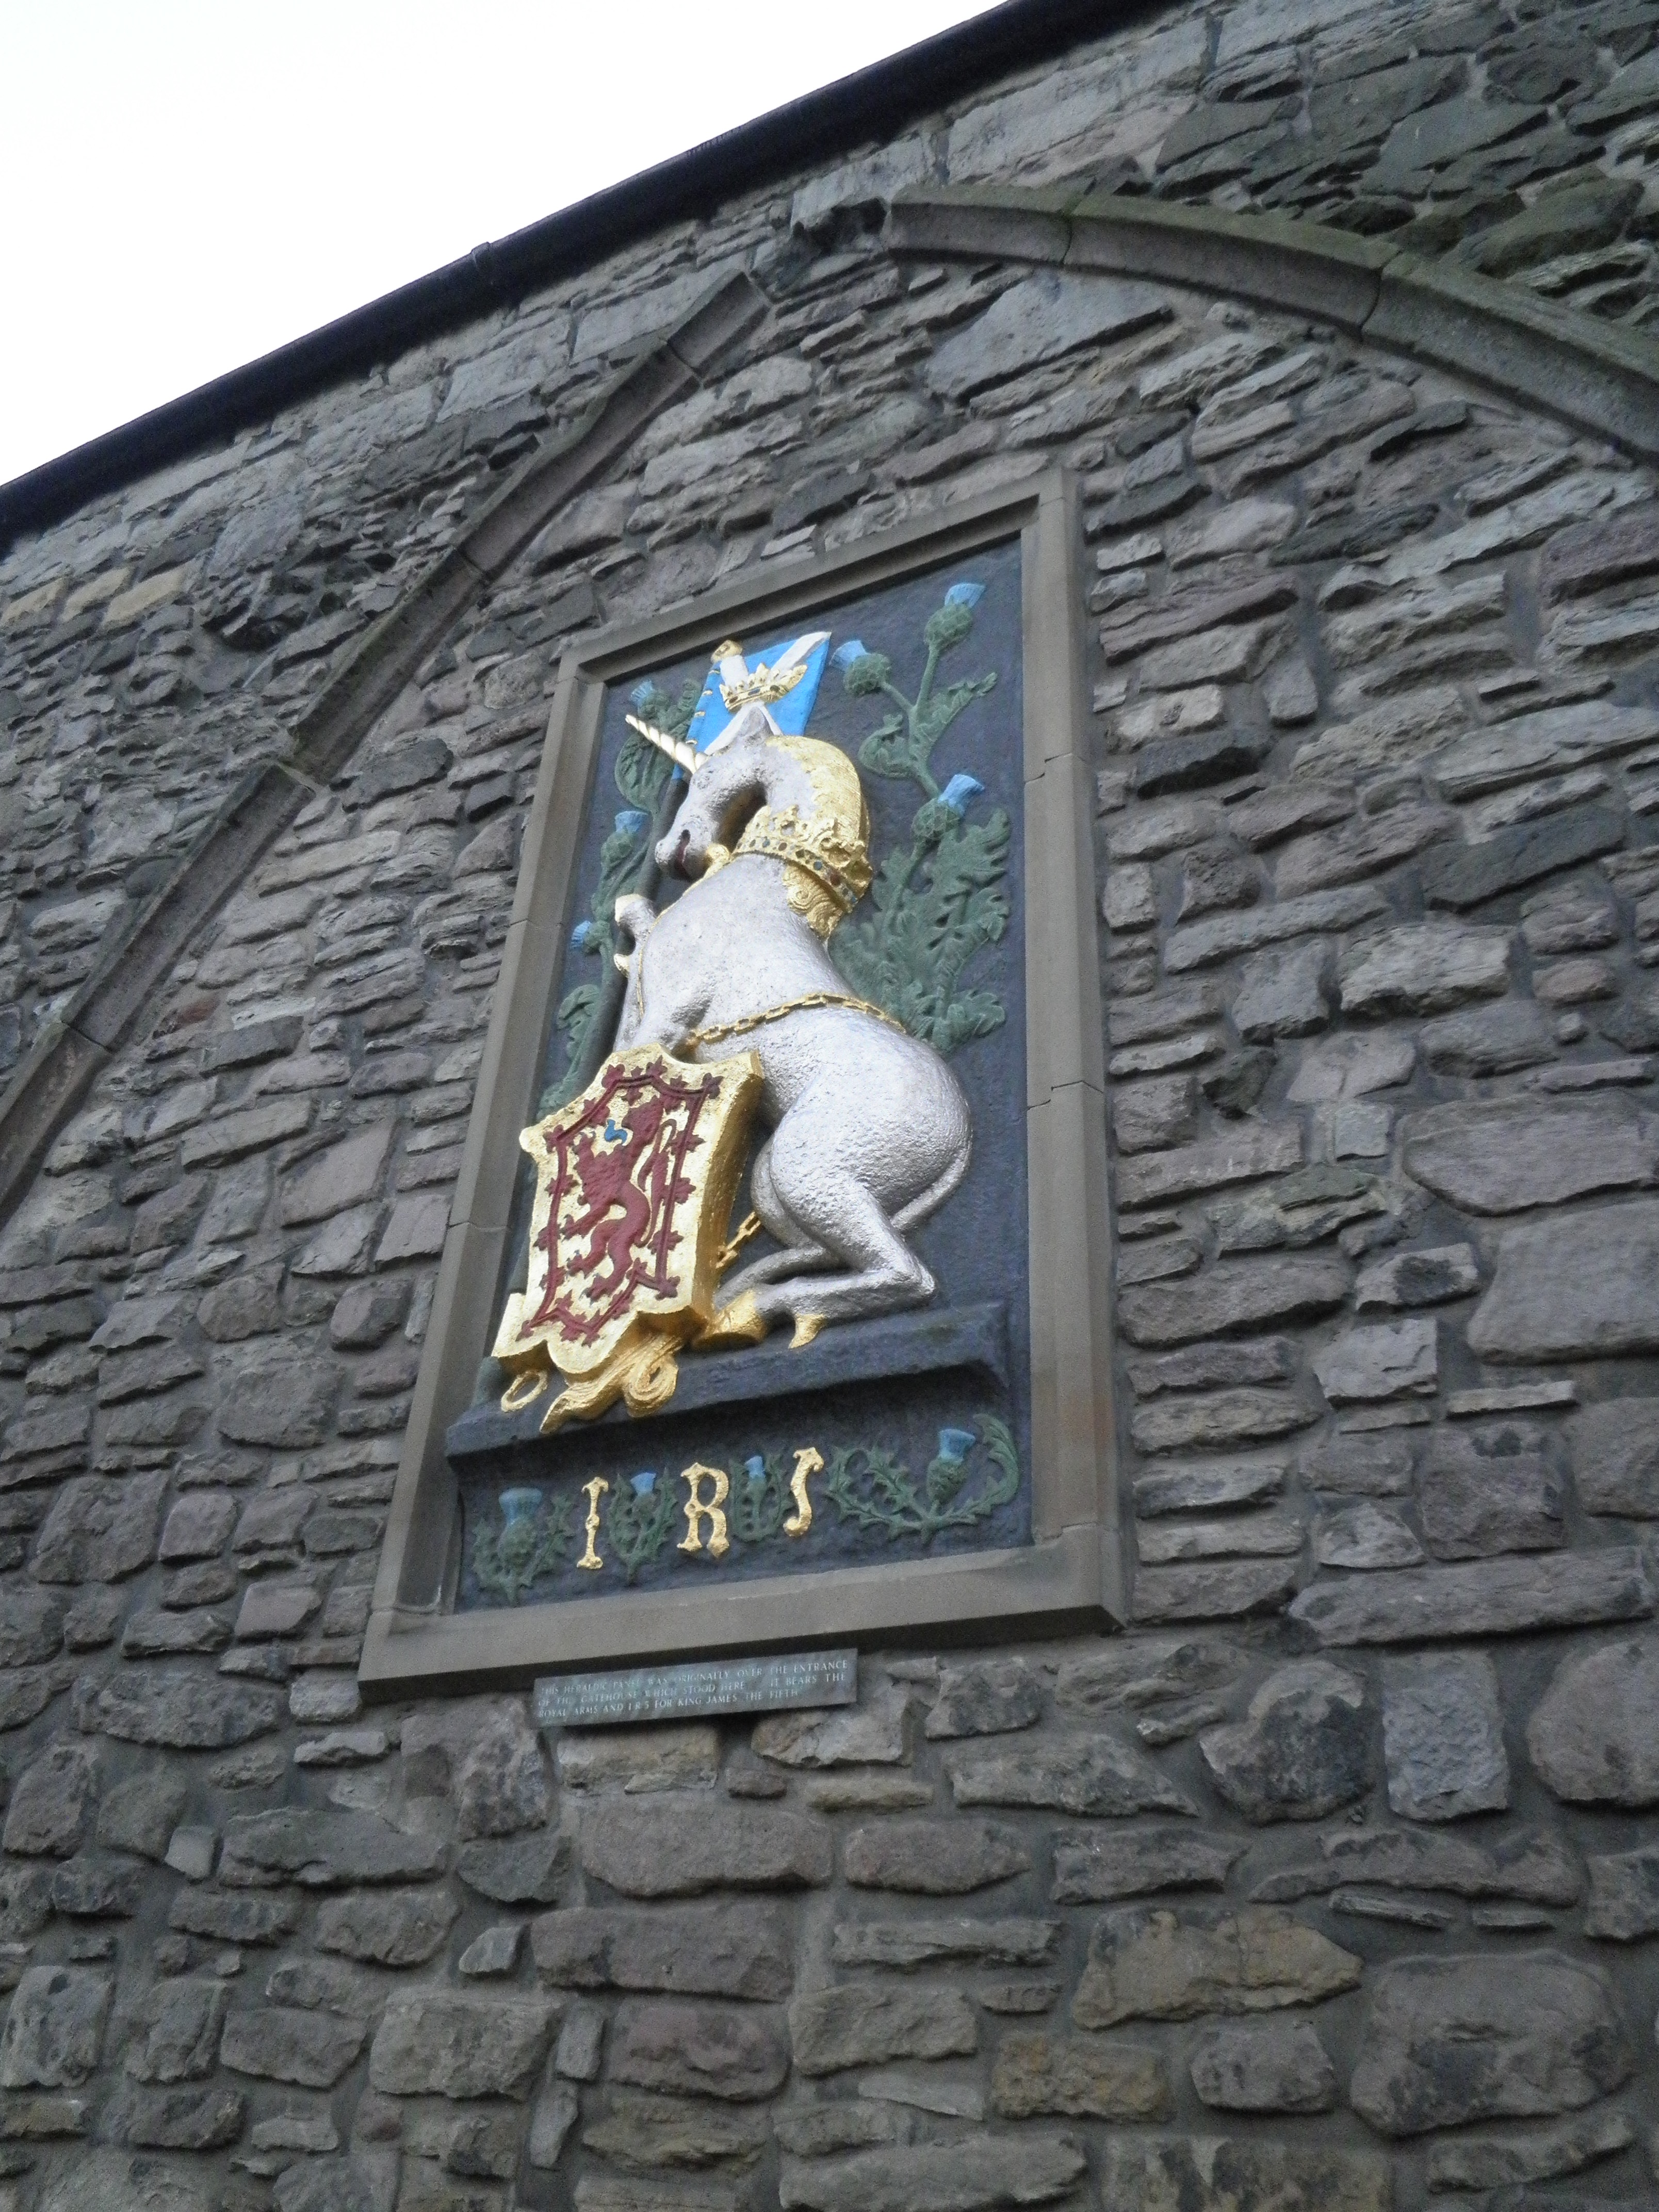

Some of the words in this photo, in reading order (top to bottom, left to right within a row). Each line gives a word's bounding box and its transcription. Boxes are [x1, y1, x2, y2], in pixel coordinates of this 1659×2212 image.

[577, 1476, 609, 1570] I
[677, 1462, 729, 1558] R
[541, 1686, 559, 1695] THIS
[648, 1677, 668, 1685] WAS
[738, 1668, 762, 1677] OVER
[771, 1665, 787, 1674] THE
[794, 1660, 848, 1672] ENTRANCE
[645, 1688, 677, 1697] WHICH
[684, 1684, 715, 1694] STOOD
[721, 1682, 744, 1690] HERE
[770, 1678, 779, 1687] IT
[787, 1676, 817, 1686] BEARS
[825, 1673, 845, 1682] THE
[539, 1709, 565, 1718] ROYAL
[575, 1706, 598, 1714] ARMS
[655, 1699, 672, 1709] FOR
[678, 1697, 701, 1706] KING
[706, 1694, 737, 1703] JAMES
[746, 1691, 762, 1700] THE
[770, 1689, 799, 1698] FIFTH
